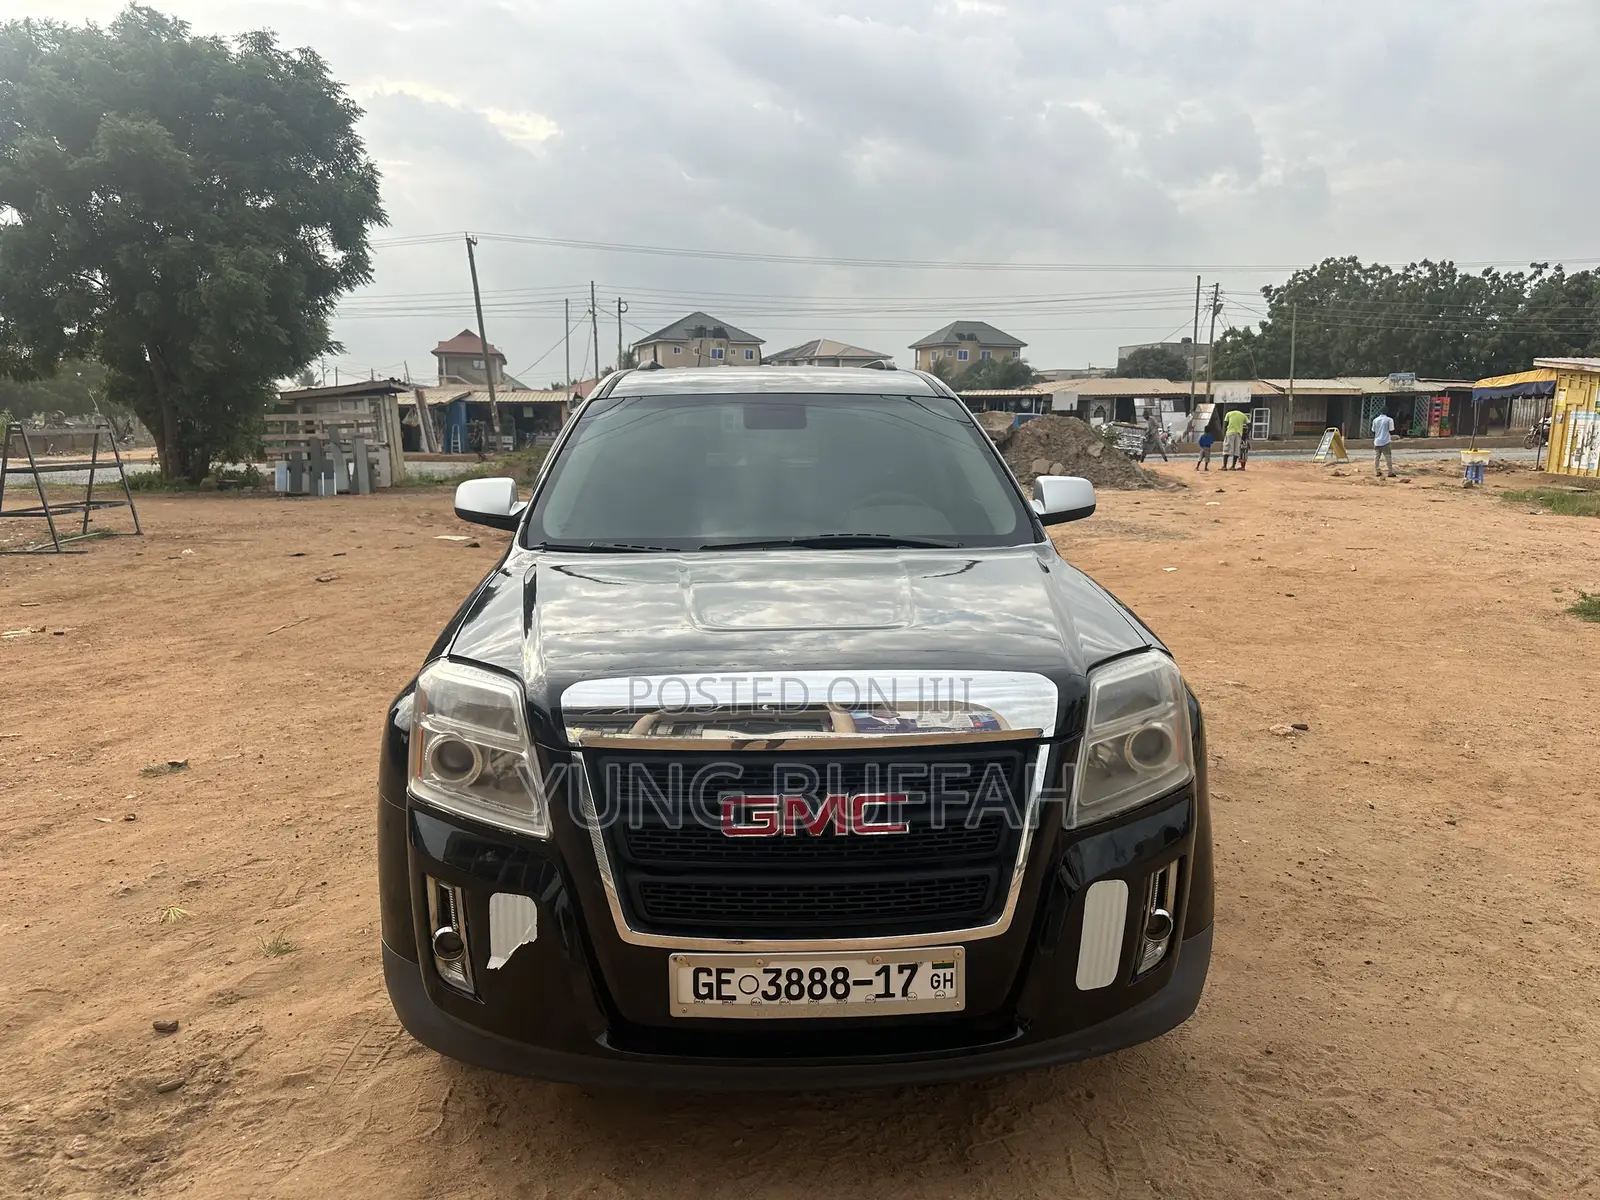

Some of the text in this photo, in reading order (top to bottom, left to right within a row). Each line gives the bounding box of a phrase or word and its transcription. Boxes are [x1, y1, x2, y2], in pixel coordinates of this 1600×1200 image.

[720, 792, 910, 838] GMC
[692, 967, 737, 1000] GE
[930, 971, 954, 990] GH
